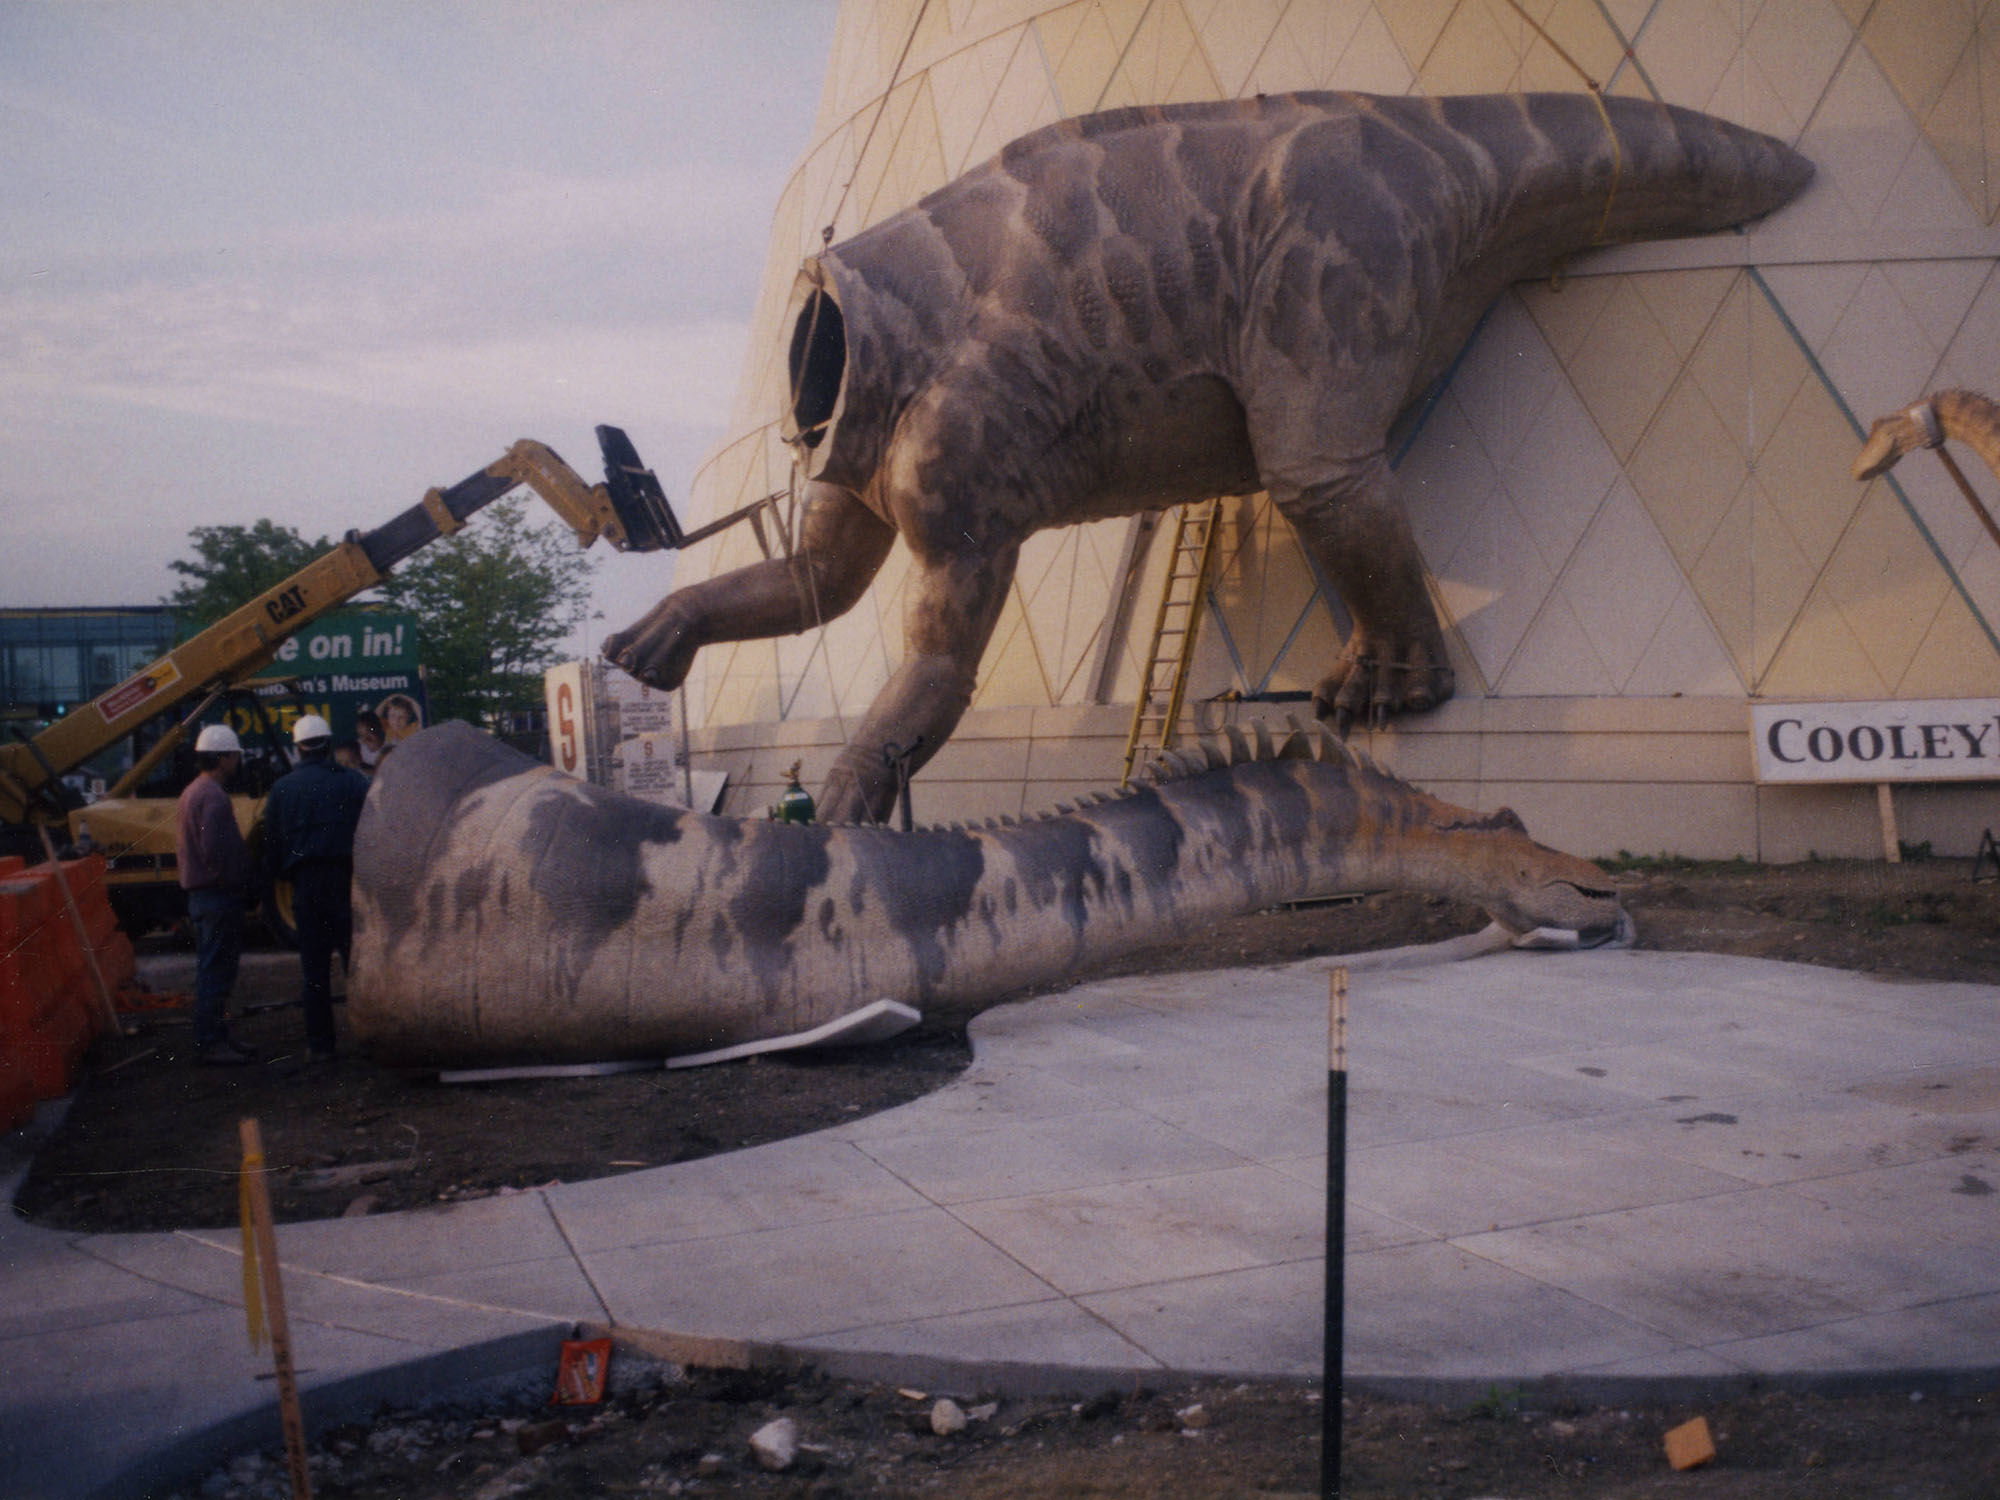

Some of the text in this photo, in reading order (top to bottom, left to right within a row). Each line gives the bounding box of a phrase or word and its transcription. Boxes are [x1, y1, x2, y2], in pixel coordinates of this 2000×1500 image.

[266, 584, 307, 624] CAT
[309, 634, 352, 659] on
[362, 624, 404, 656] in!
[331, 674, 408, 692] Museum
[557, 682, 578, 771] S
[1767, 715, 2000, 763] COOLEY
